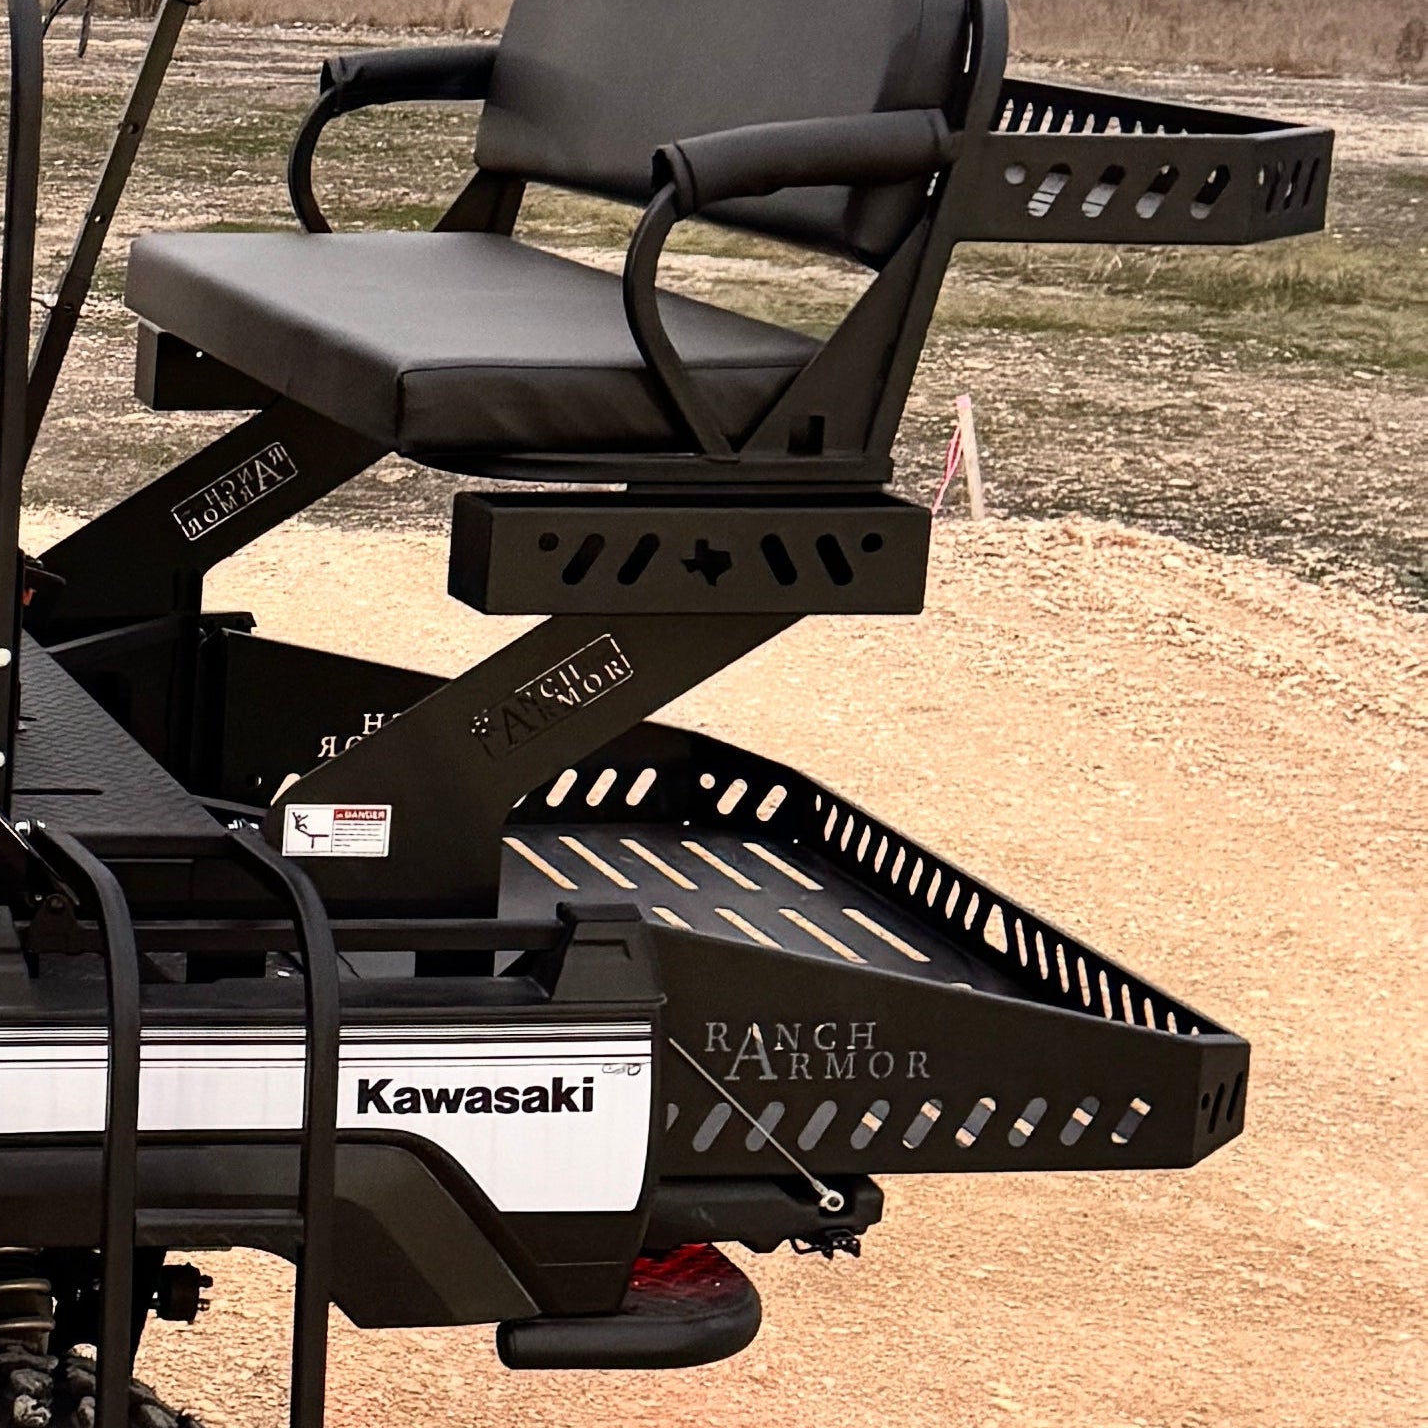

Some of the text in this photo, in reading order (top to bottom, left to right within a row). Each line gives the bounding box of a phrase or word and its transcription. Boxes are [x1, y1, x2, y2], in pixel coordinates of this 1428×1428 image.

[344, 810, 385, 820] DANGER
[704, 1022, 877, 1080] RANCH
[724, 1023, 931, 1080] ARMOR
[356, 1076, 594, 1114] Kawasaki
